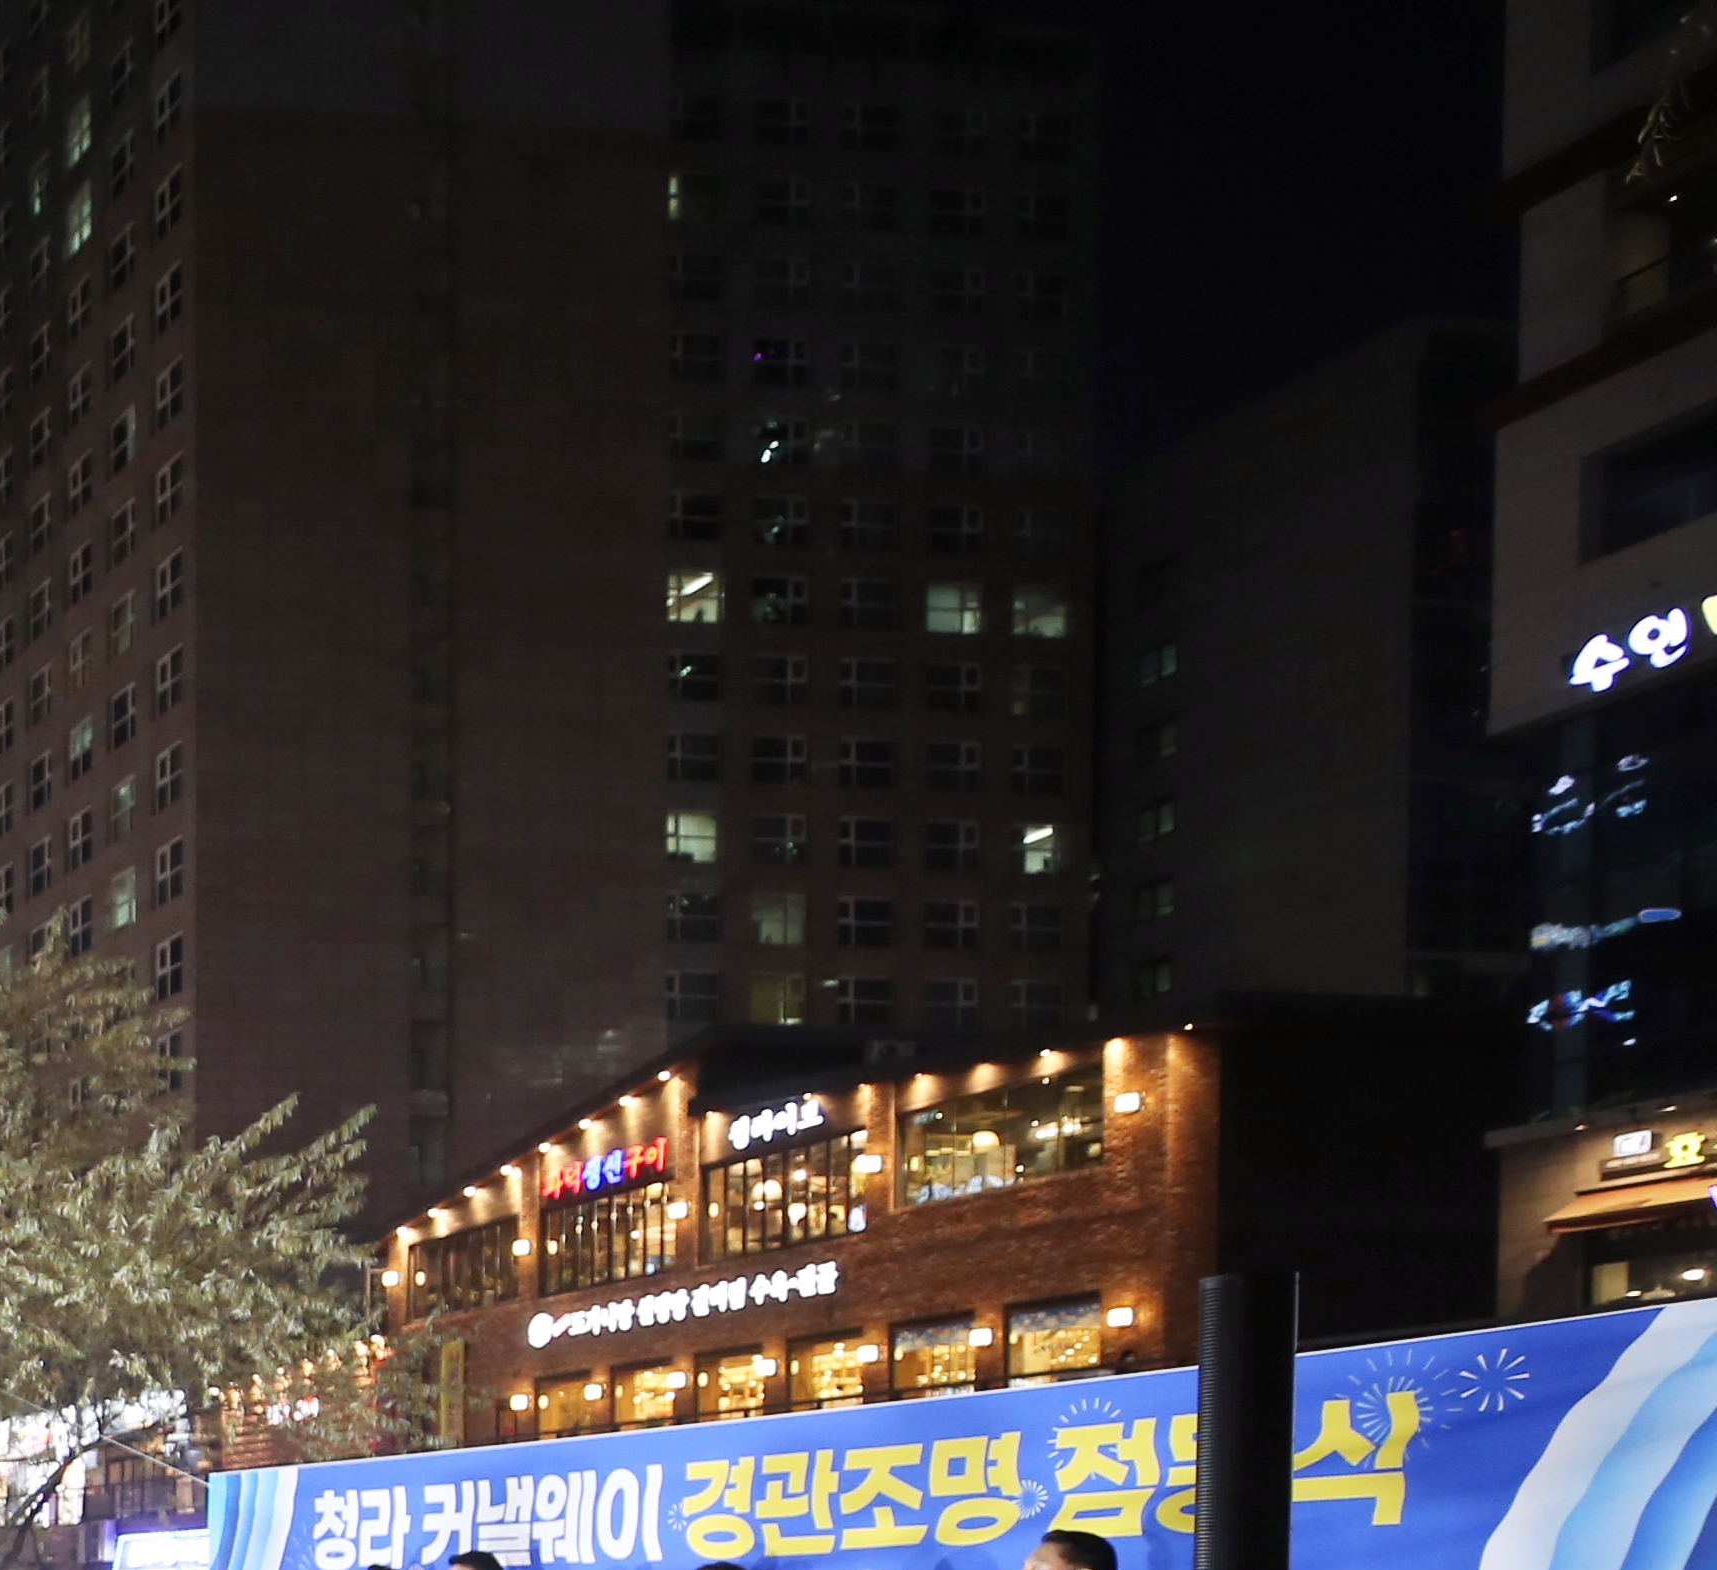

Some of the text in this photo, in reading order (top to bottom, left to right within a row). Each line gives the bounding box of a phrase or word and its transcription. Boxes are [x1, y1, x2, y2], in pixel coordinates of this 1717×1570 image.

[542, 1136, 668, 1198] 화덕생선구이
[420, 1462, 664, 1567] 커낼웨이
[682, 1430, 1023, 1561] 경관조명
